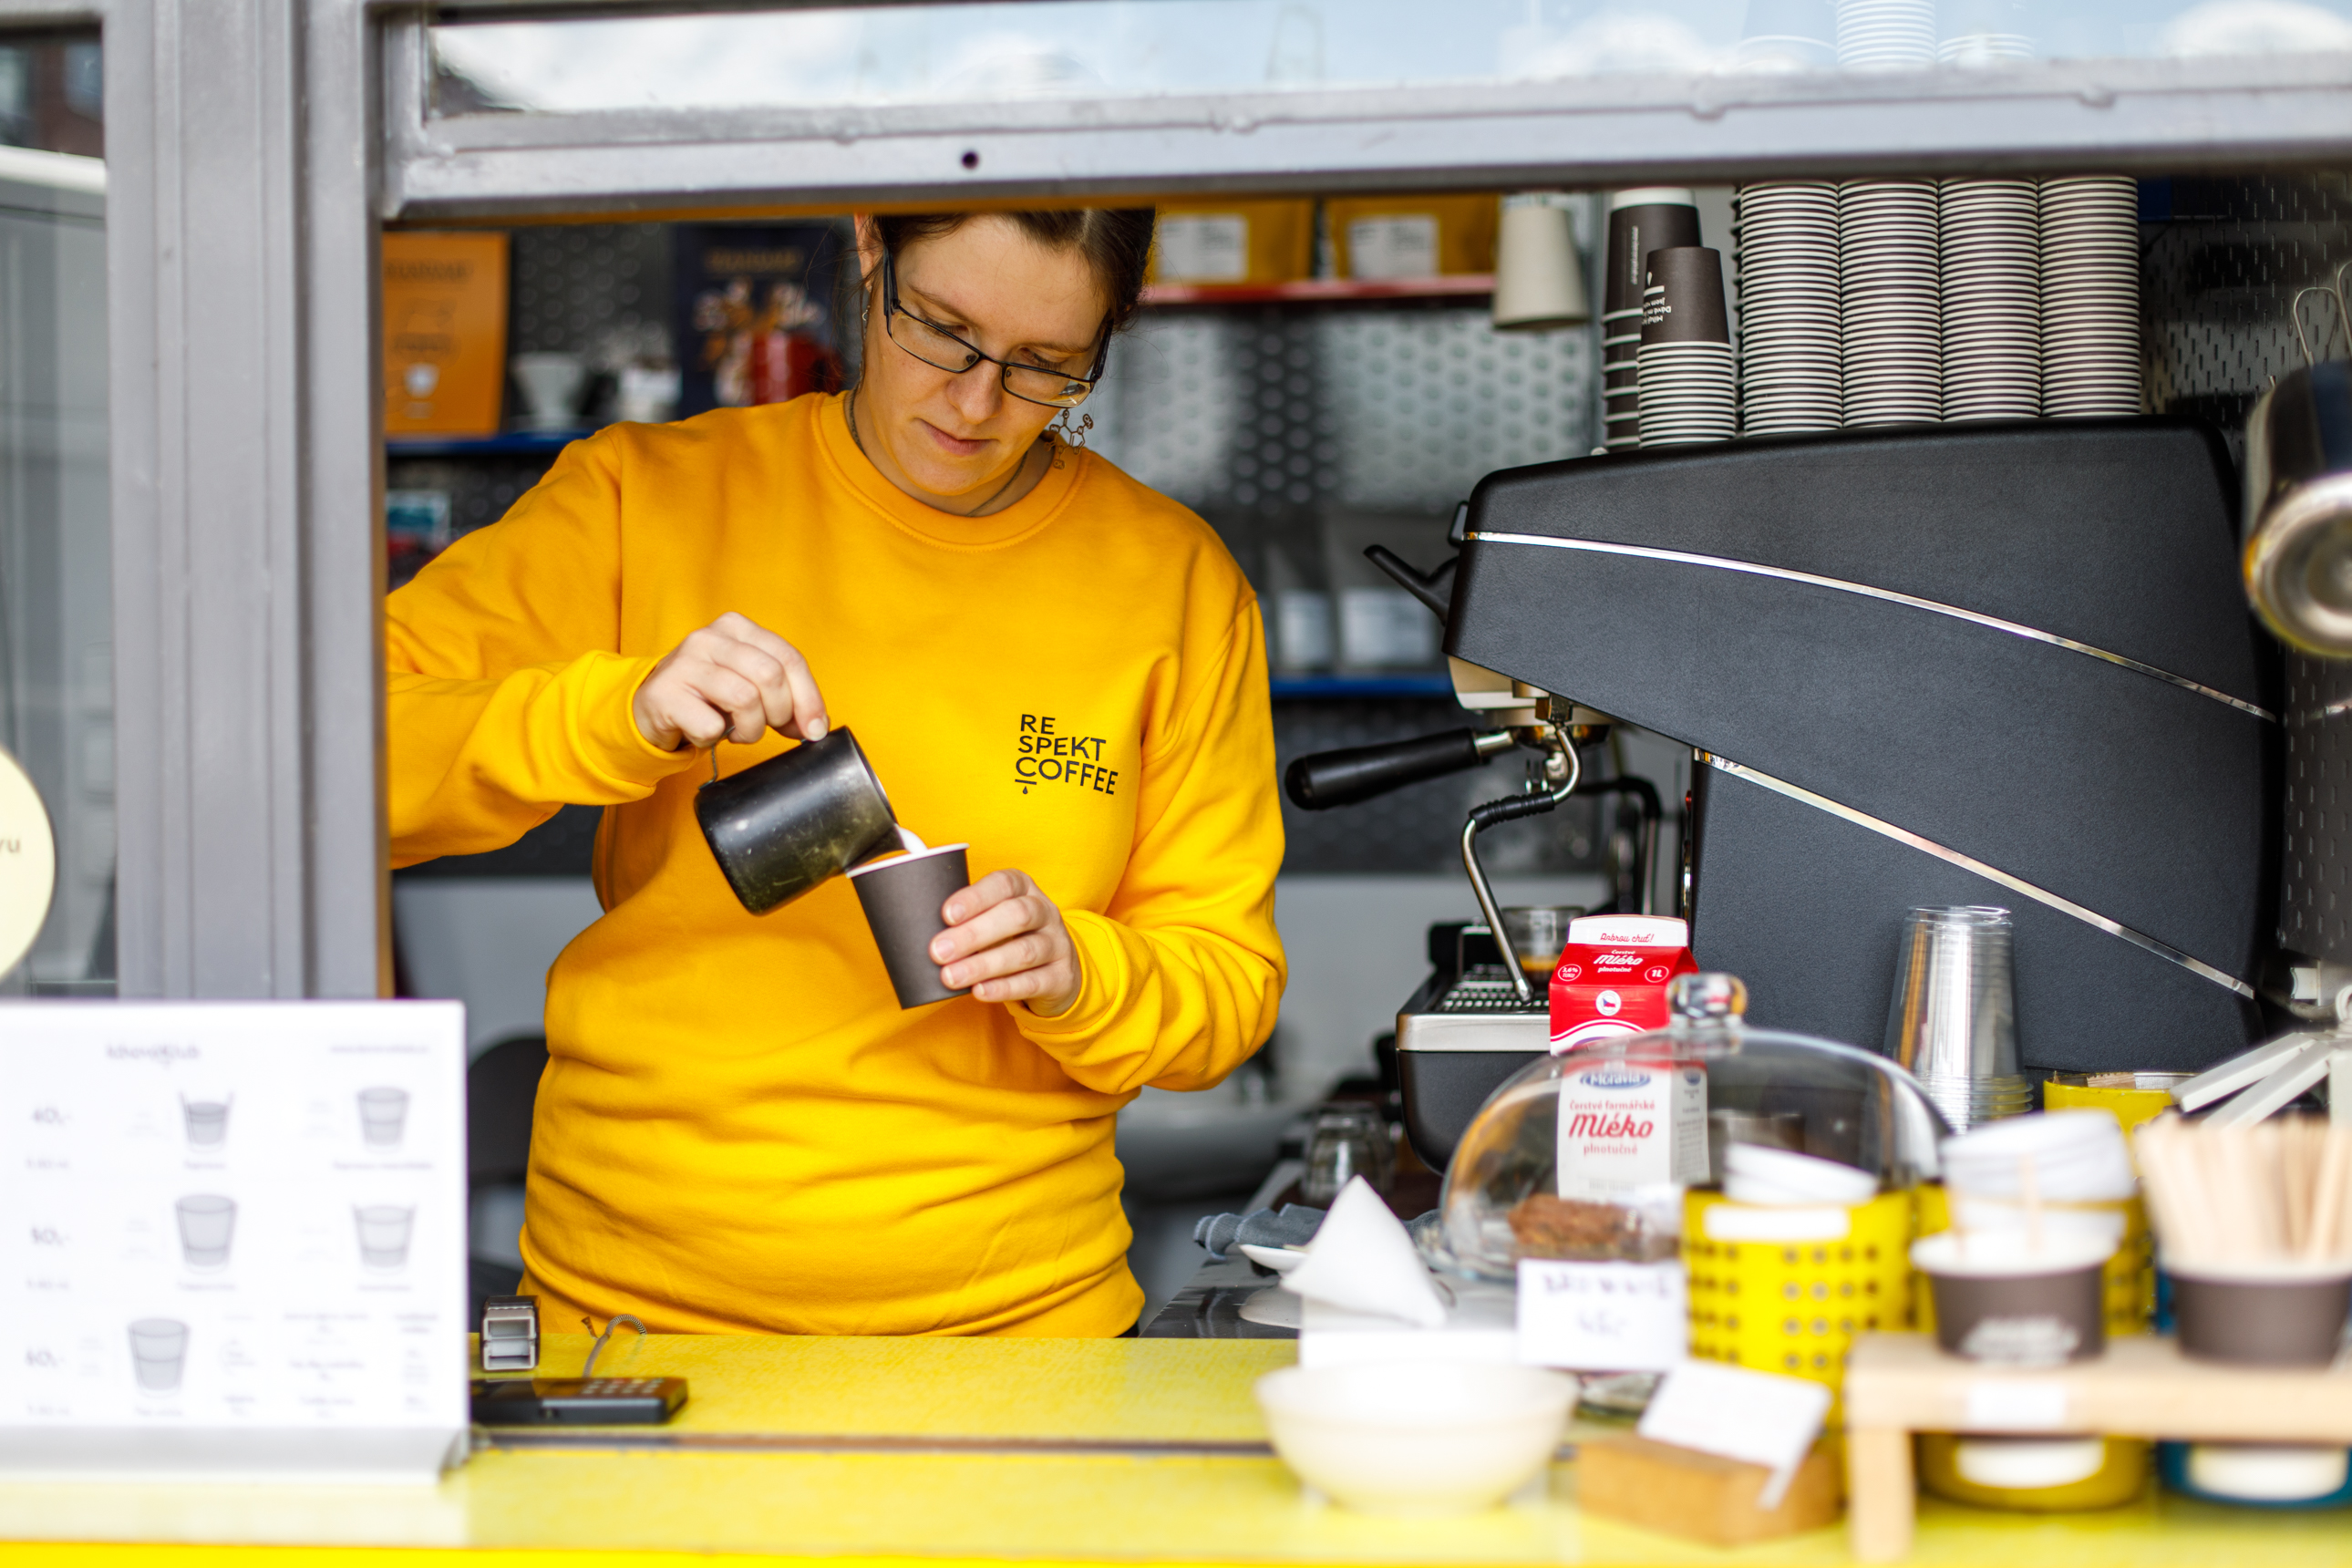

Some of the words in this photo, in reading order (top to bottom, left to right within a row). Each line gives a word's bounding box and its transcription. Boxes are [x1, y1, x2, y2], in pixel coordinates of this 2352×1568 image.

[1020, 714, 1056, 735] RE
[1017, 735, 1107, 762] SPEKT
[1016, 756, 1119, 795] COFFEE
[1594, 954, 1644, 965] Mléko
[1568, 1112, 1654, 1139] Mléko
[1583, 1143, 1637, 1157] plnotučné
